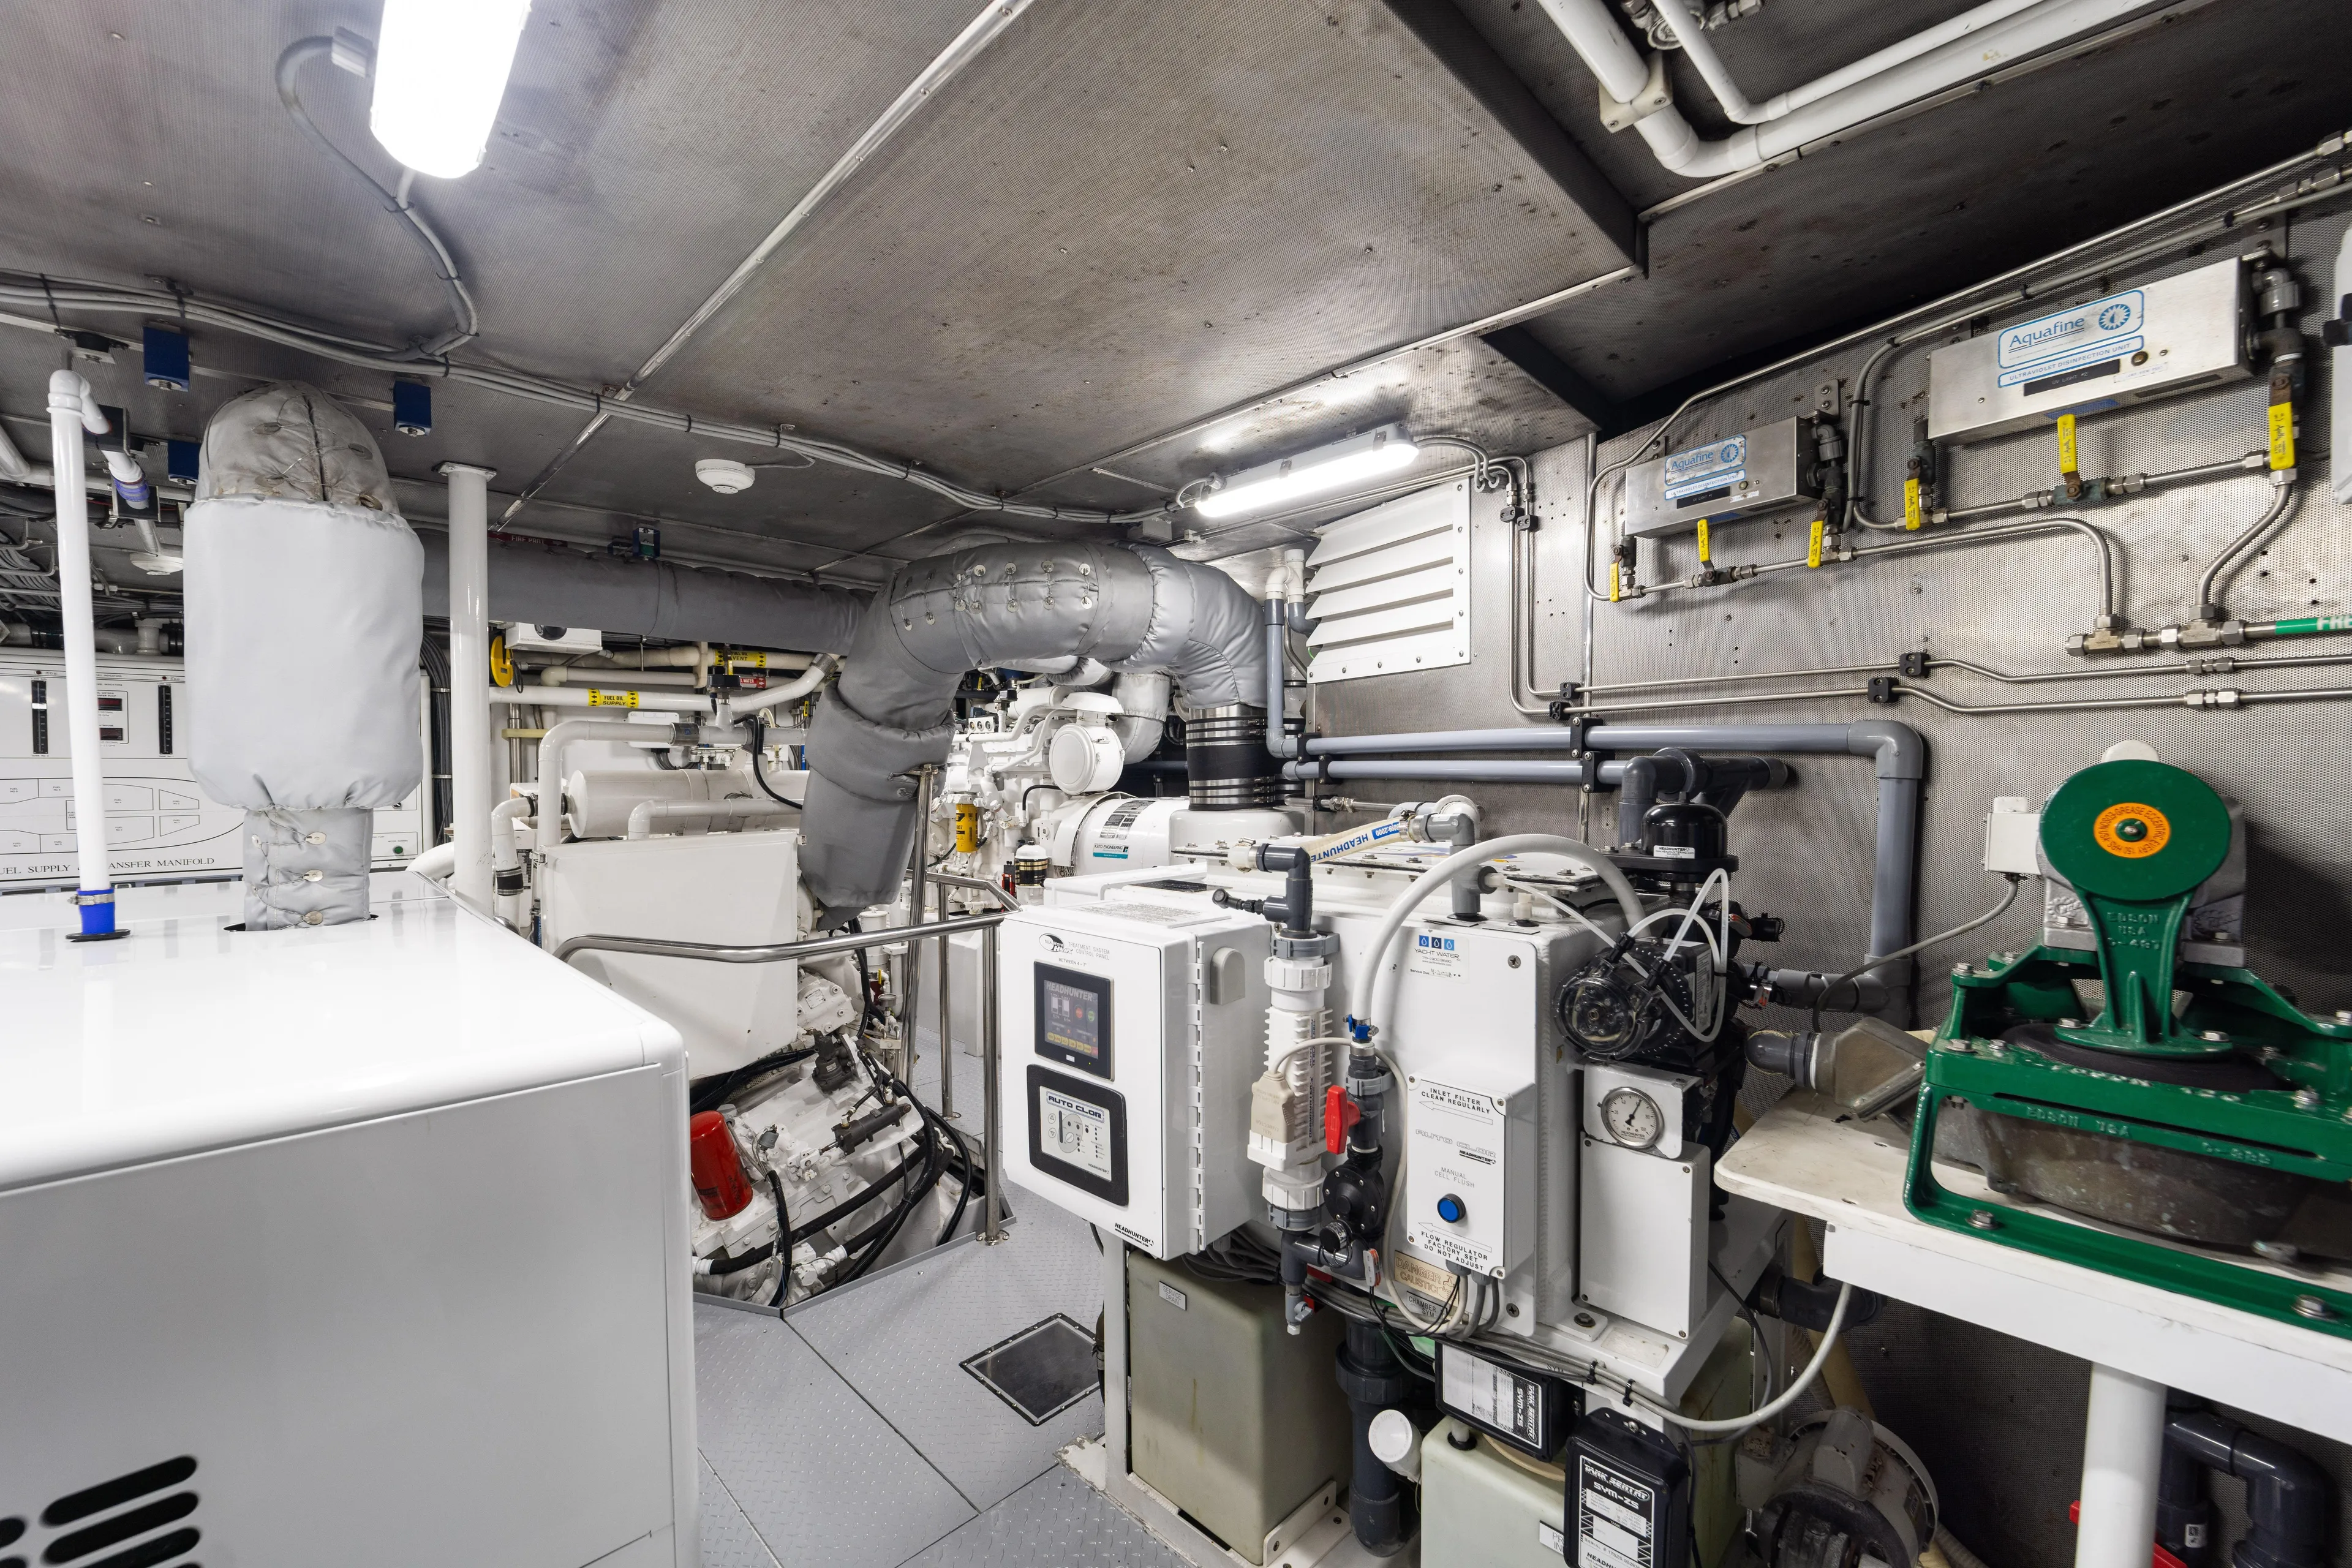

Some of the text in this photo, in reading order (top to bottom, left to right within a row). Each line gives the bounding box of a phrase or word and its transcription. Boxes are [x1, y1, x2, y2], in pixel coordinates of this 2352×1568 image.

[2009, 317, 2085, 348] Aquafine
[2010, 363, 2057, 380] ULTRAVIOLET
[2058, 349, 2110, 367] DISINFECTION
[2112, 343, 2131, 353] UNIT
[1672, 451, 1714, 470] Aquafine
[1671, 484, 1697, 496] ULTRAVIOLET
[1698, 477, 1728, 488] DISINFECTION
[1311, 833, 1369, 862] HEADHUNTE
[2138, 839, 2160, 854] EVERY
[28, 864, 71, 873] SUPPLY
[108, 861, 151, 869] ANSFER
[157, 858, 214, 867] MANIFOLD
[2107, 912, 2159, 924] EDSON
[2118, 925, 2146, 935] USA
[1068, 941, 1091, 951] TREATMENT
[1076, 948, 1094, 957] CONTROL
[1046, 981, 1093, 1002] HEADHUNTER
[1421, 1091, 1490, 1114] CLEAN REGULARLY
[1430, 1087, 1480, 1106] INLET FILTER
[1048, 1095, 1102, 1119] AUTO CLOR
[2026, 1106, 2132, 1137] EDSON USA
[1415, 1129, 1496, 1158] AUTO CLOR
[1459, 1150, 1492, 1163] HEADHUNTER
[1088, 1163, 1107, 1173] HEADHUNTER
[1441, 1166, 1467, 1180] MANUAL
[1434, 1170, 1475, 1188] CELL FLUSH
[1115, 1223, 1149, 1243] HEADHUNTER
[1421, 1231, 1488, 1261] FLOW REGULATOR
[1428, 1239, 1478, 1262] FACTORY SET
[1437, 1249, 1452, 1259] NOT
[1456, 1257, 1484, 1271] ADJUST
[1396, 1256, 1441, 1285] DANGER
[1400, 1271, 1437, 1294] CAUSTIC
[1163, 1286, 1182, 1301] SERVICE
[1166, 1293, 1179, 1305] DRAIN
[1409, 1295, 1436, 1313] CHAMBER
[1422, 1308, 1434, 1317] SYM
[1584, 1464, 1608, 1479] TANK
[1610, 1520, 1621, 1529] TANK
[1584, 1537, 1600, 1550] SERIAL
